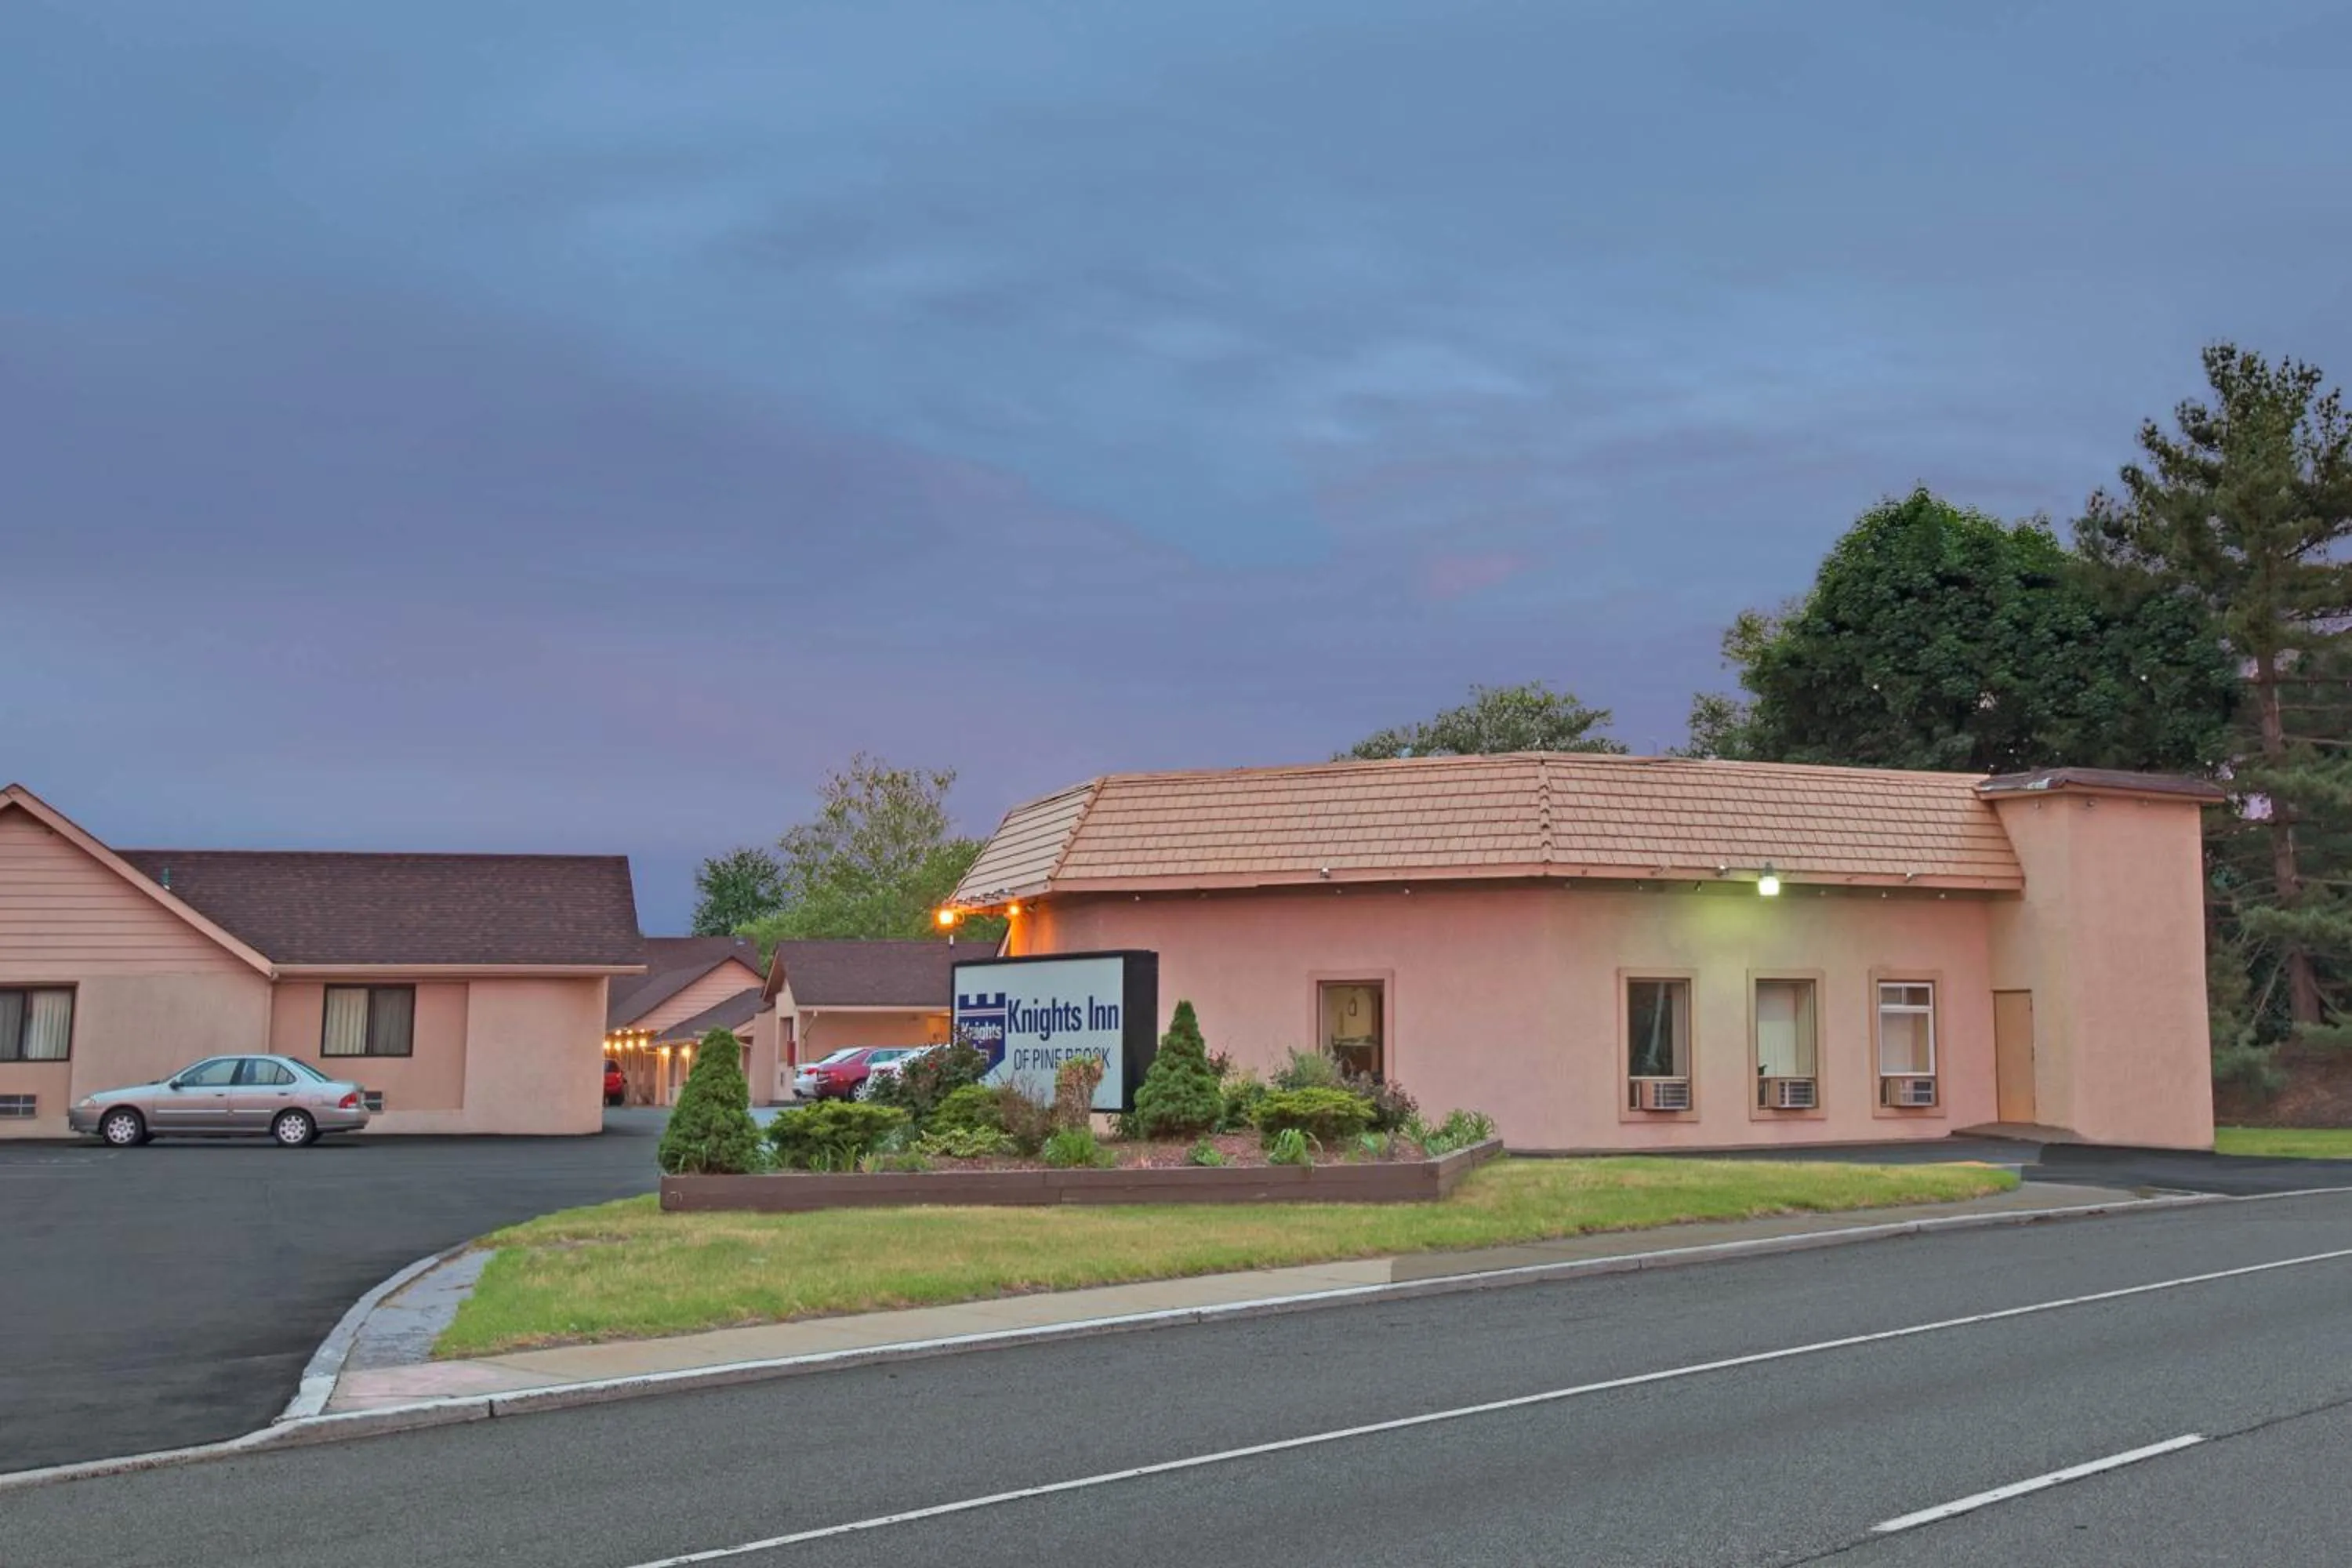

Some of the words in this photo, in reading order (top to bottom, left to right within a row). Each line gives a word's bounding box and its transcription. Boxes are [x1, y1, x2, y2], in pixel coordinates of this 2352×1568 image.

[1007, 997, 1082, 1041] Knights
[1088, 995, 1119, 1031] Inn
[1014, 1048, 1029, 1070] OF
[1033, 1047, 1062, 1070] PINE
